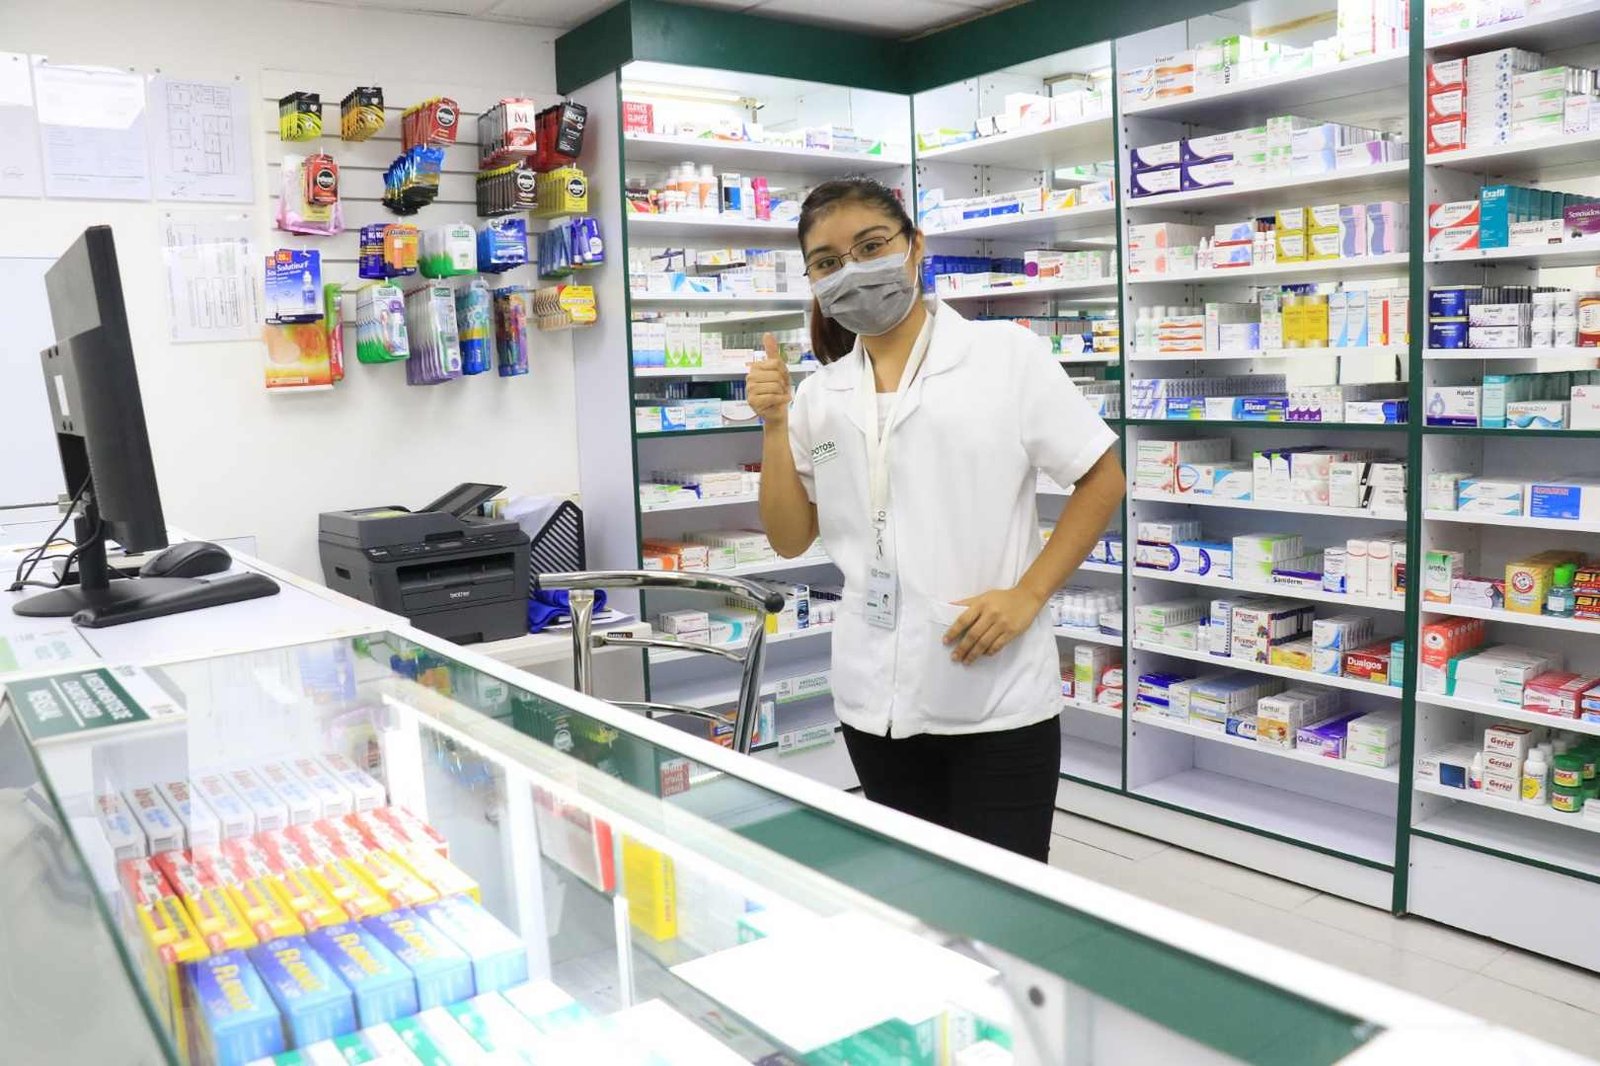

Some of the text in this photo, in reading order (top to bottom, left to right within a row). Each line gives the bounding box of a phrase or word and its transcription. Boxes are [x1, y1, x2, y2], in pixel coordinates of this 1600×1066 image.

[1346, 655, 1382, 671] Dualgos
[1490, 736, 1515, 749] Gerial
[1488, 757, 1513, 770] Gerial
[1488, 779, 1513, 792] Gerial
